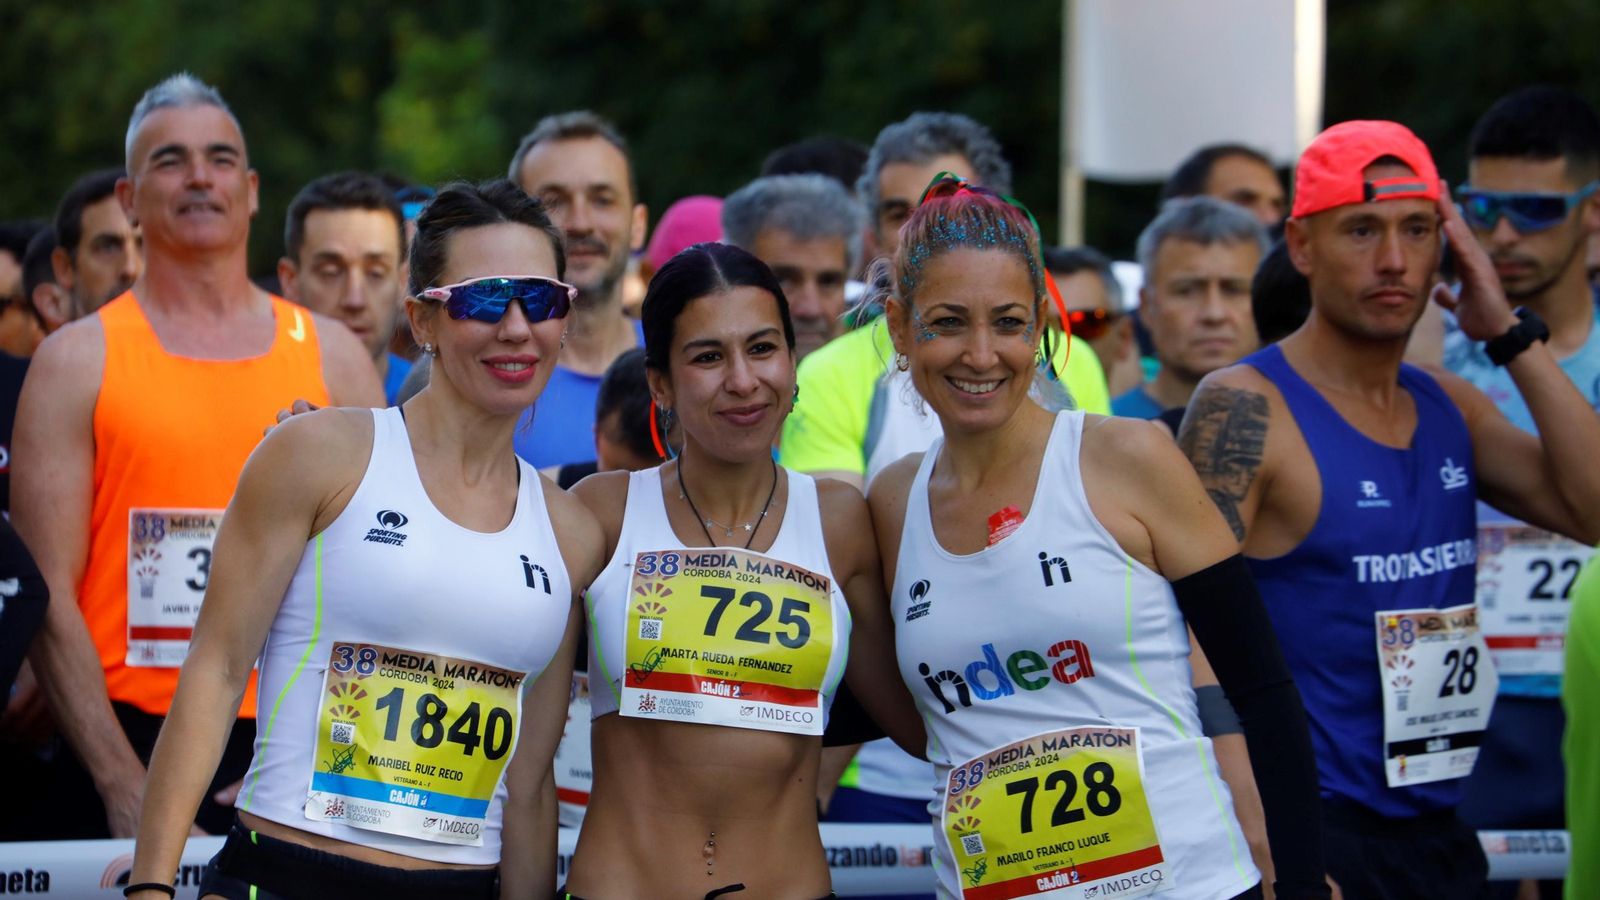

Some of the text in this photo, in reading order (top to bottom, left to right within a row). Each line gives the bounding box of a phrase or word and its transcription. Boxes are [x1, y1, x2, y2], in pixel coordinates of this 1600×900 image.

[367, 528, 407, 540] SPORTING
[637, 552, 828, 593] 38 MEDIA MARATÓN
[736, 572, 761, 585] 2024
[700, 585, 811, 649] 725
[332, 645, 379, 676] 38
[381, 652, 436, 676] MEDIA
[661, 647, 793, 675] MARTA RUEDA FERNANDEZ
[1437, 646, 1479, 699] 28
[432, 677, 455, 690] 2024
[701, 680, 731, 697] CAJÓN
[918, 639, 1095, 715] indea
[659, 697, 704, 710] AYUNTAMIENTO
[757, 706, 814, 724] IMDECO
[375, 686, 513, 761] 1840
[367, 755, 463, 782] MARIBEL RUIZ RECIO
[949, 729, 1131, 794] 38 MEDIA MARATÓN
[1034, 753, 1060, 767] 2024
[389, 789, 420, 807] CAJÓN
[1005, 761, 1122, 834] 728
[439, 818, 480, 835] IMDECO
[997, 833, 1111, 867] MARILO FRANCO LUQUE
[1037, 870, 1070, 891] CAJÓN
[1101, 869, 1163, 895] IMDECO
